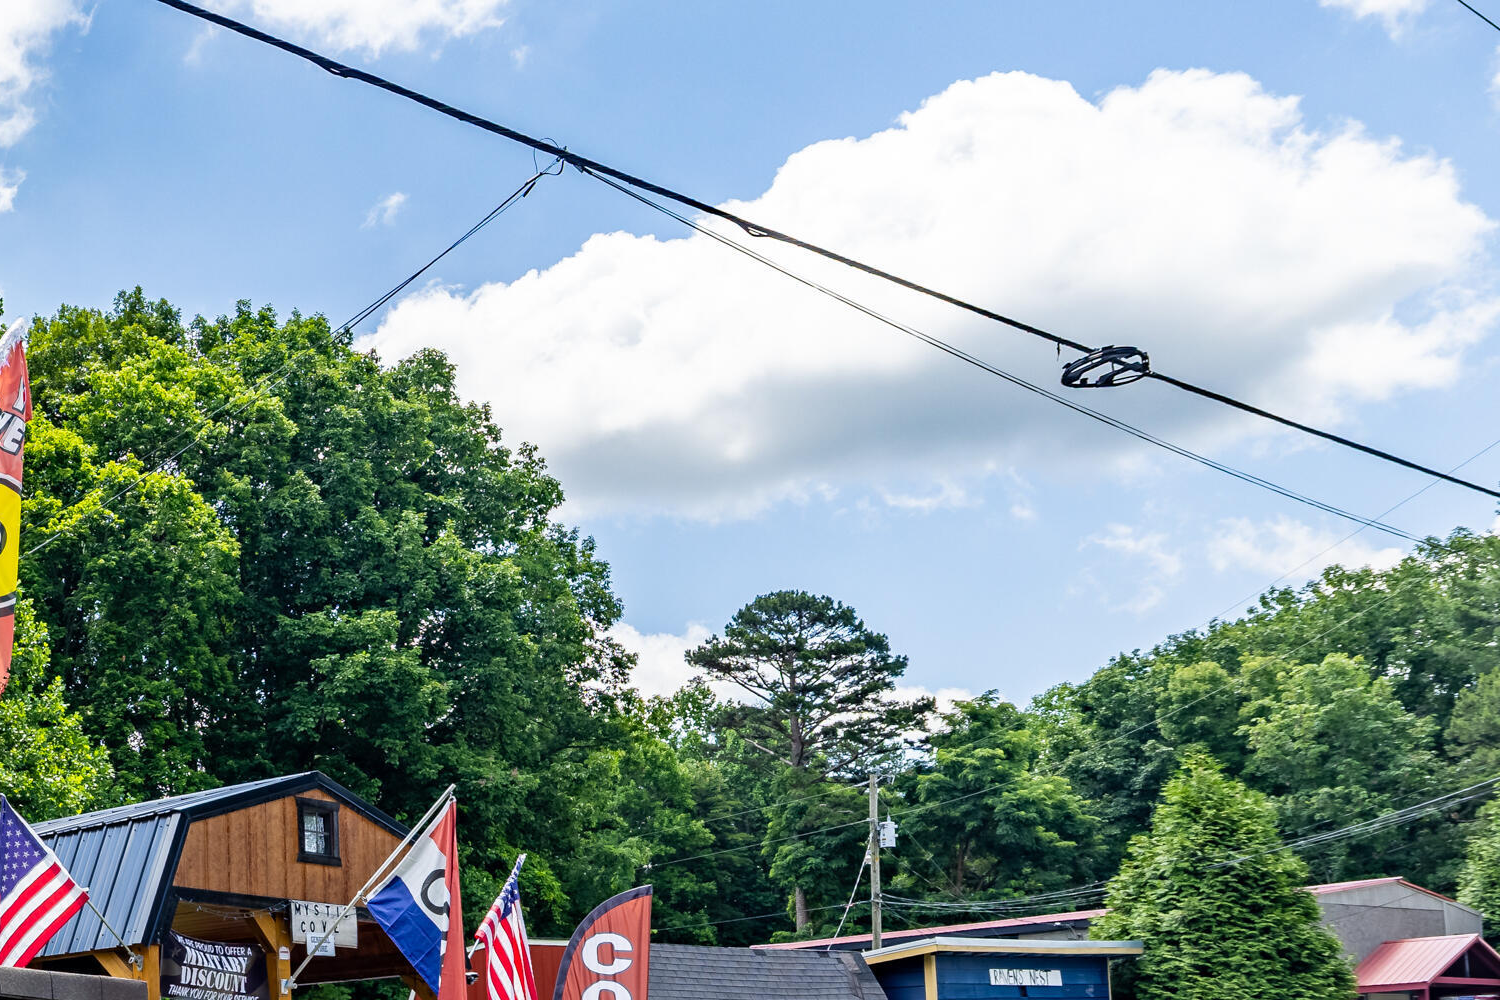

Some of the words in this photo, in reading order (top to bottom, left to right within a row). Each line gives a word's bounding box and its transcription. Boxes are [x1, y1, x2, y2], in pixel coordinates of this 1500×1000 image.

[195, 941, 214, 954] PROUD
[215, 945, 224, 955] TO
[225, 946, 245, 956] OFFER
[247, 947, 253, 956] A
[183, 946, 248, 974] MILITARY
[180, 965, 248, 993] DISCOUNT
[168, 984, 190, 997] THANK
[189, 987, 204, 1000] YOU
[204, 990, 217, 1000] FOR
